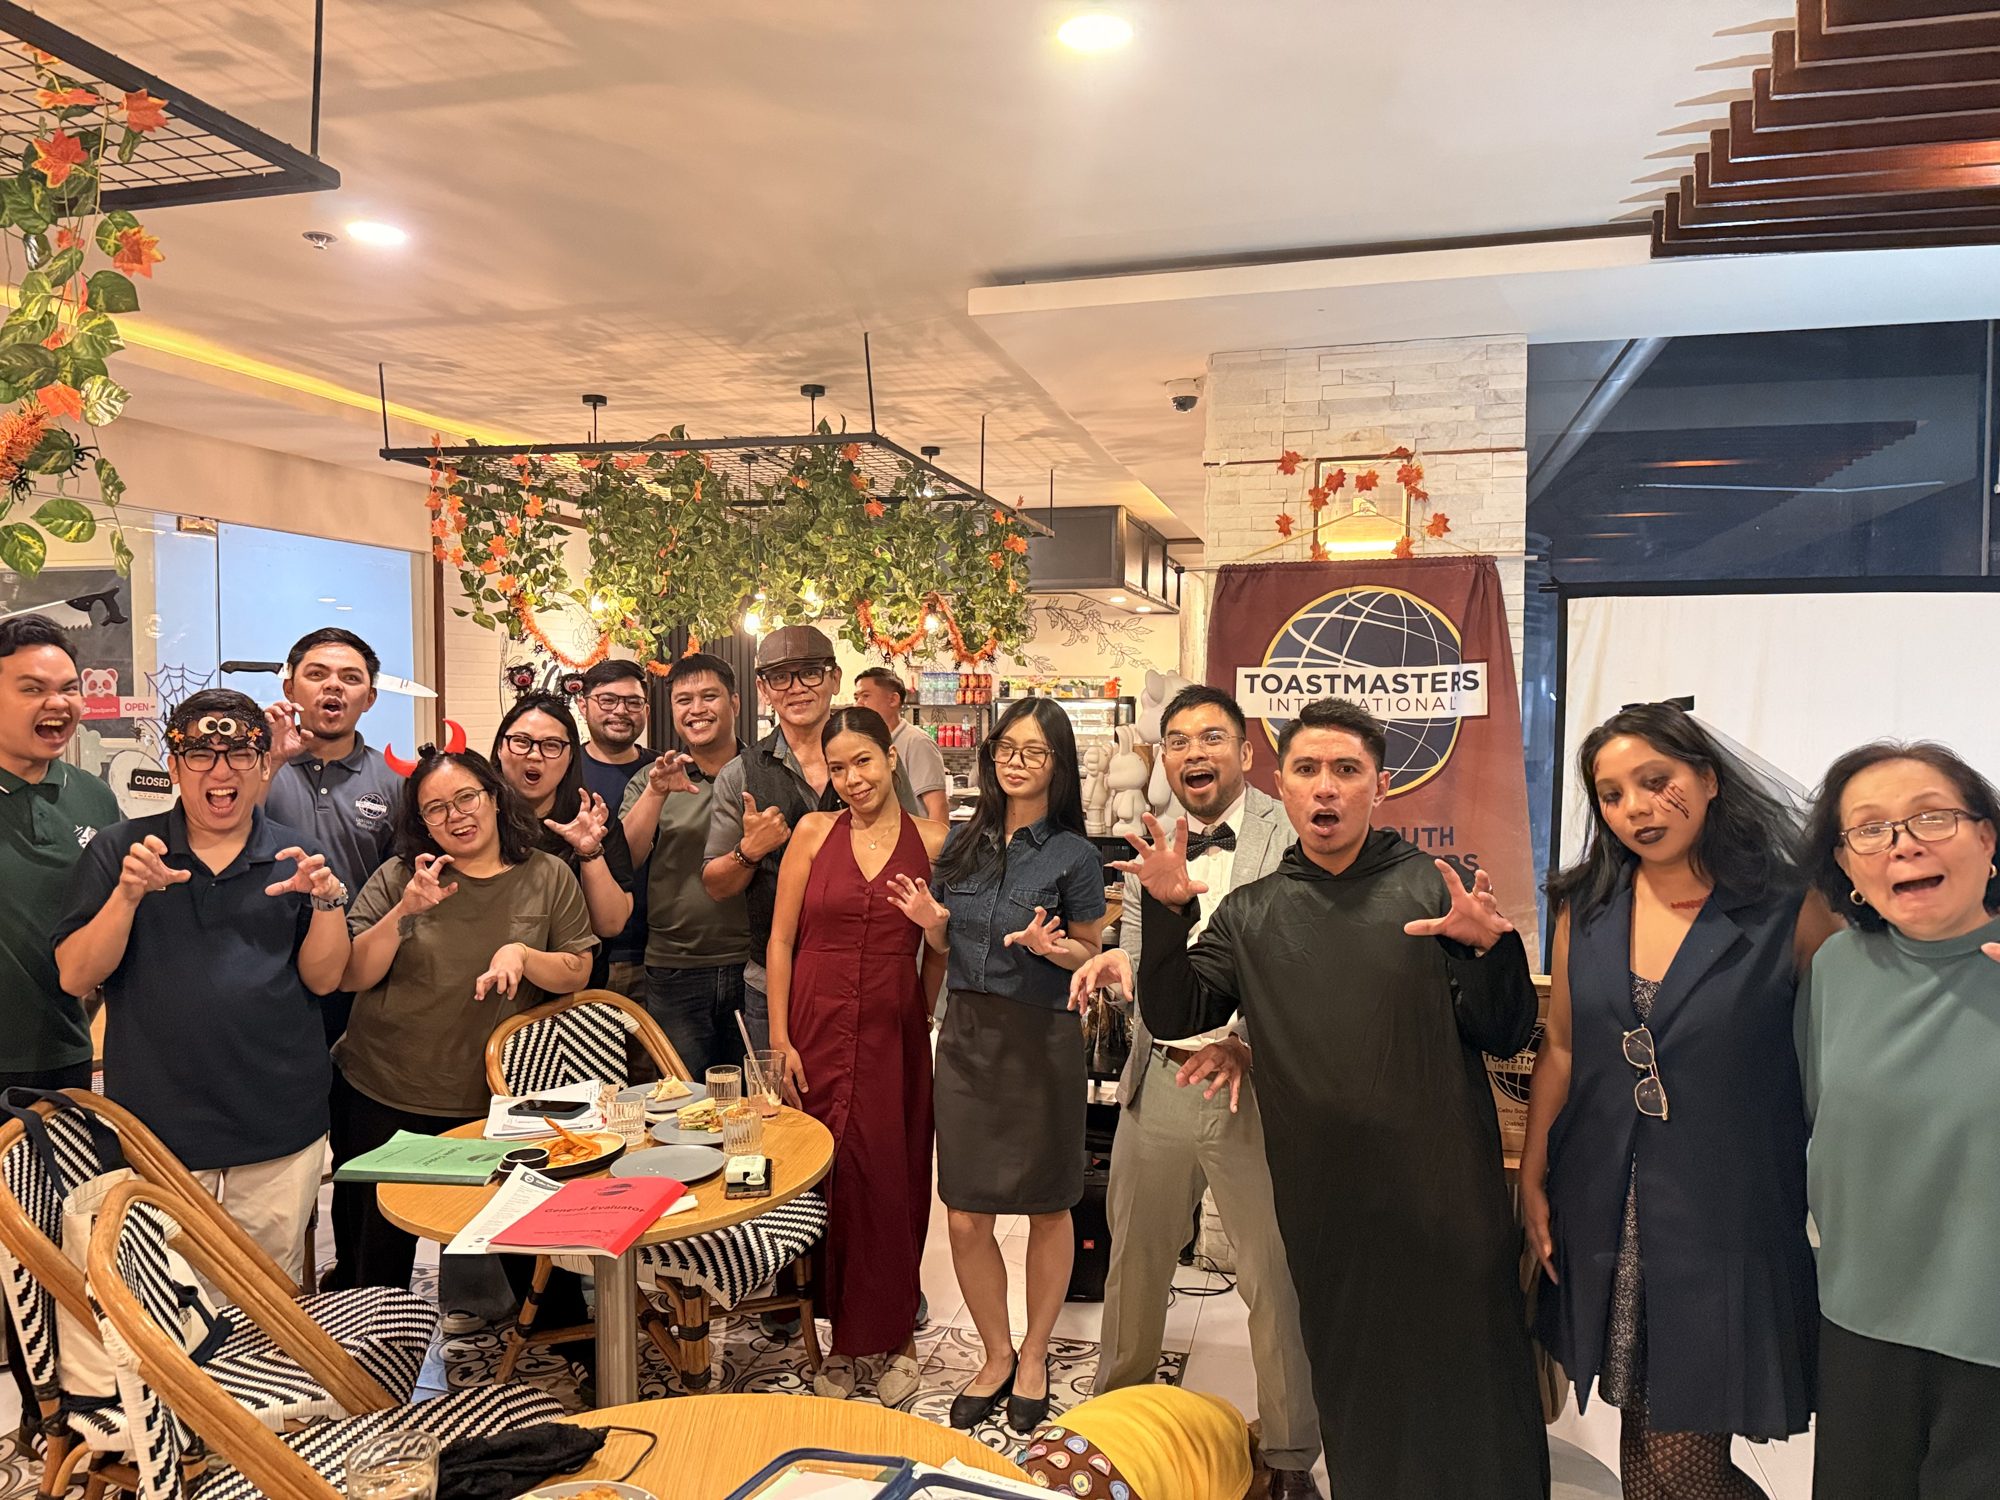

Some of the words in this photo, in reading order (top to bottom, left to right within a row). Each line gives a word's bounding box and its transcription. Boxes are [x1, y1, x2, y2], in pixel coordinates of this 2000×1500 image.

[1244, 670, 1480, 695] TOASTMASTERS
[124, 702, 149, 711] OPEN
[1269, 696, 1456, 712] INTATIONAL
[135, 775, 170, 787] CLOSED
[590, 1204, 645, 1213] Evaluator
